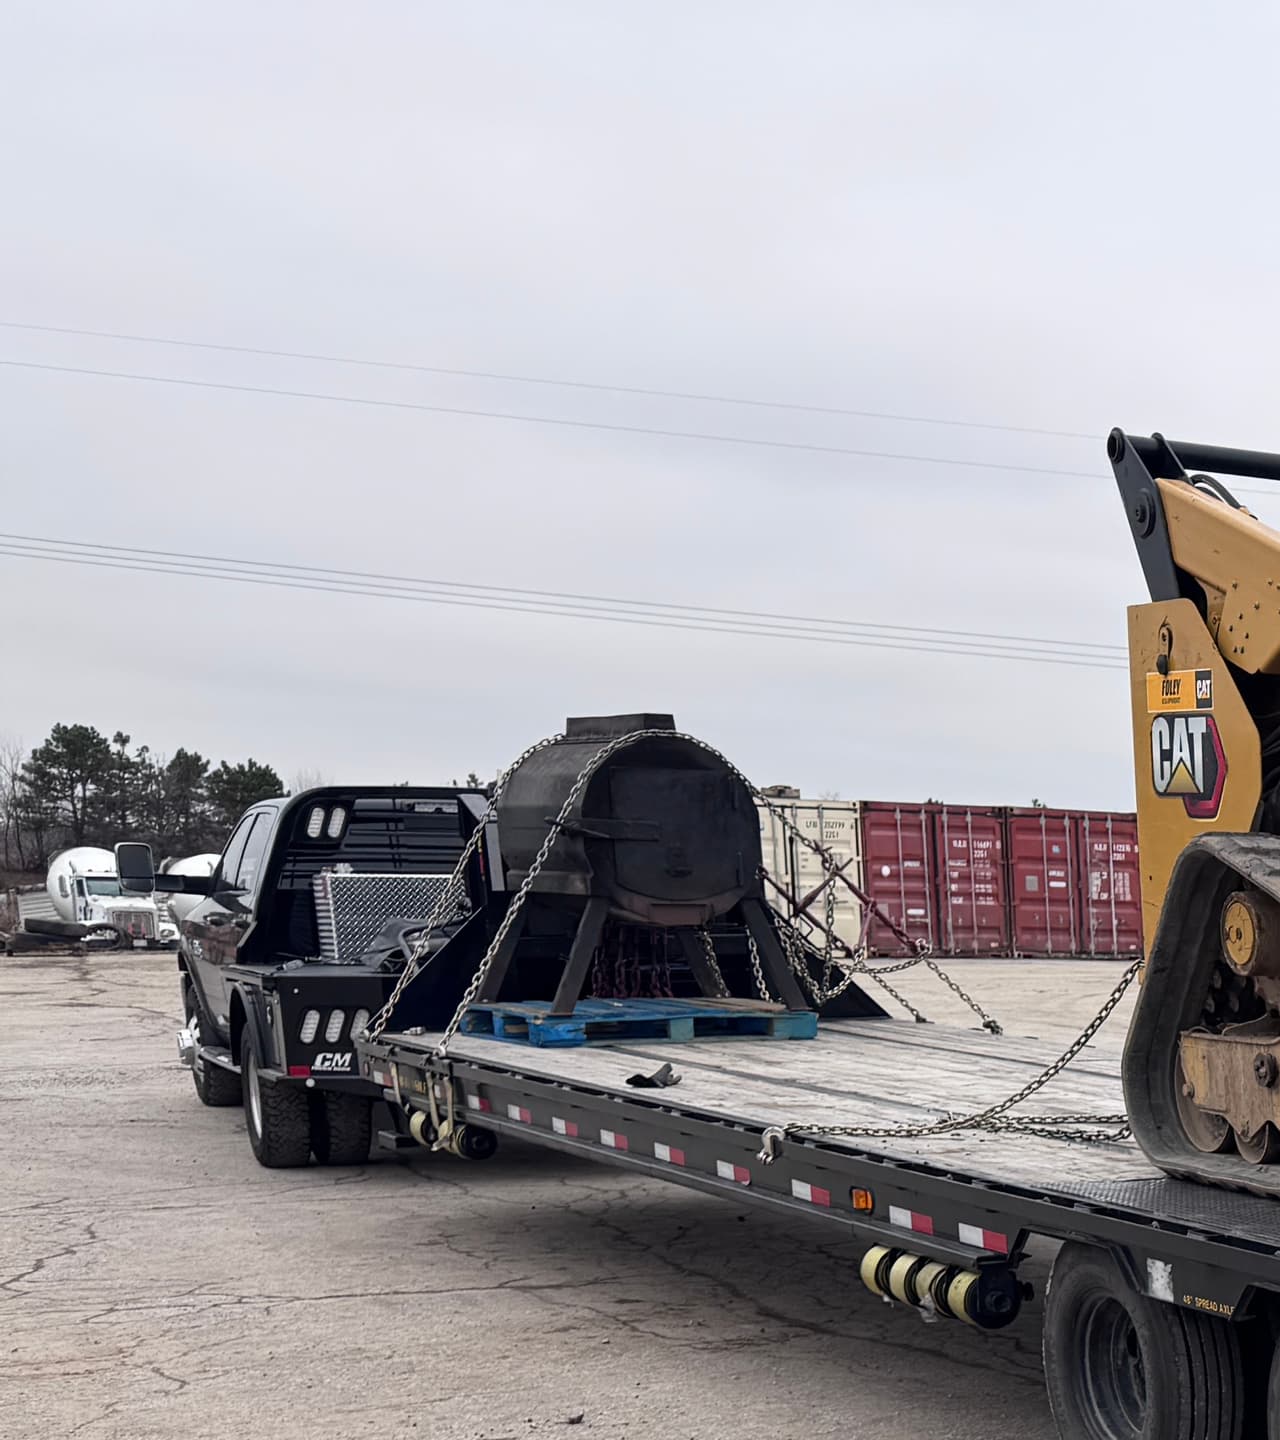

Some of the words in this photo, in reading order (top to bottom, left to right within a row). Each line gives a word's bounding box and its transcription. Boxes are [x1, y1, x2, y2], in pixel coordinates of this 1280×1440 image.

[1161, 679, 1181, 697] FOLEY
[1196, 680, 1211, 699] CAT
[1152, 717, 1206, 793] CAT
[314, 1053, 352, 1067] CM
[1194, 1297, 1218, 1311] SPREAD
